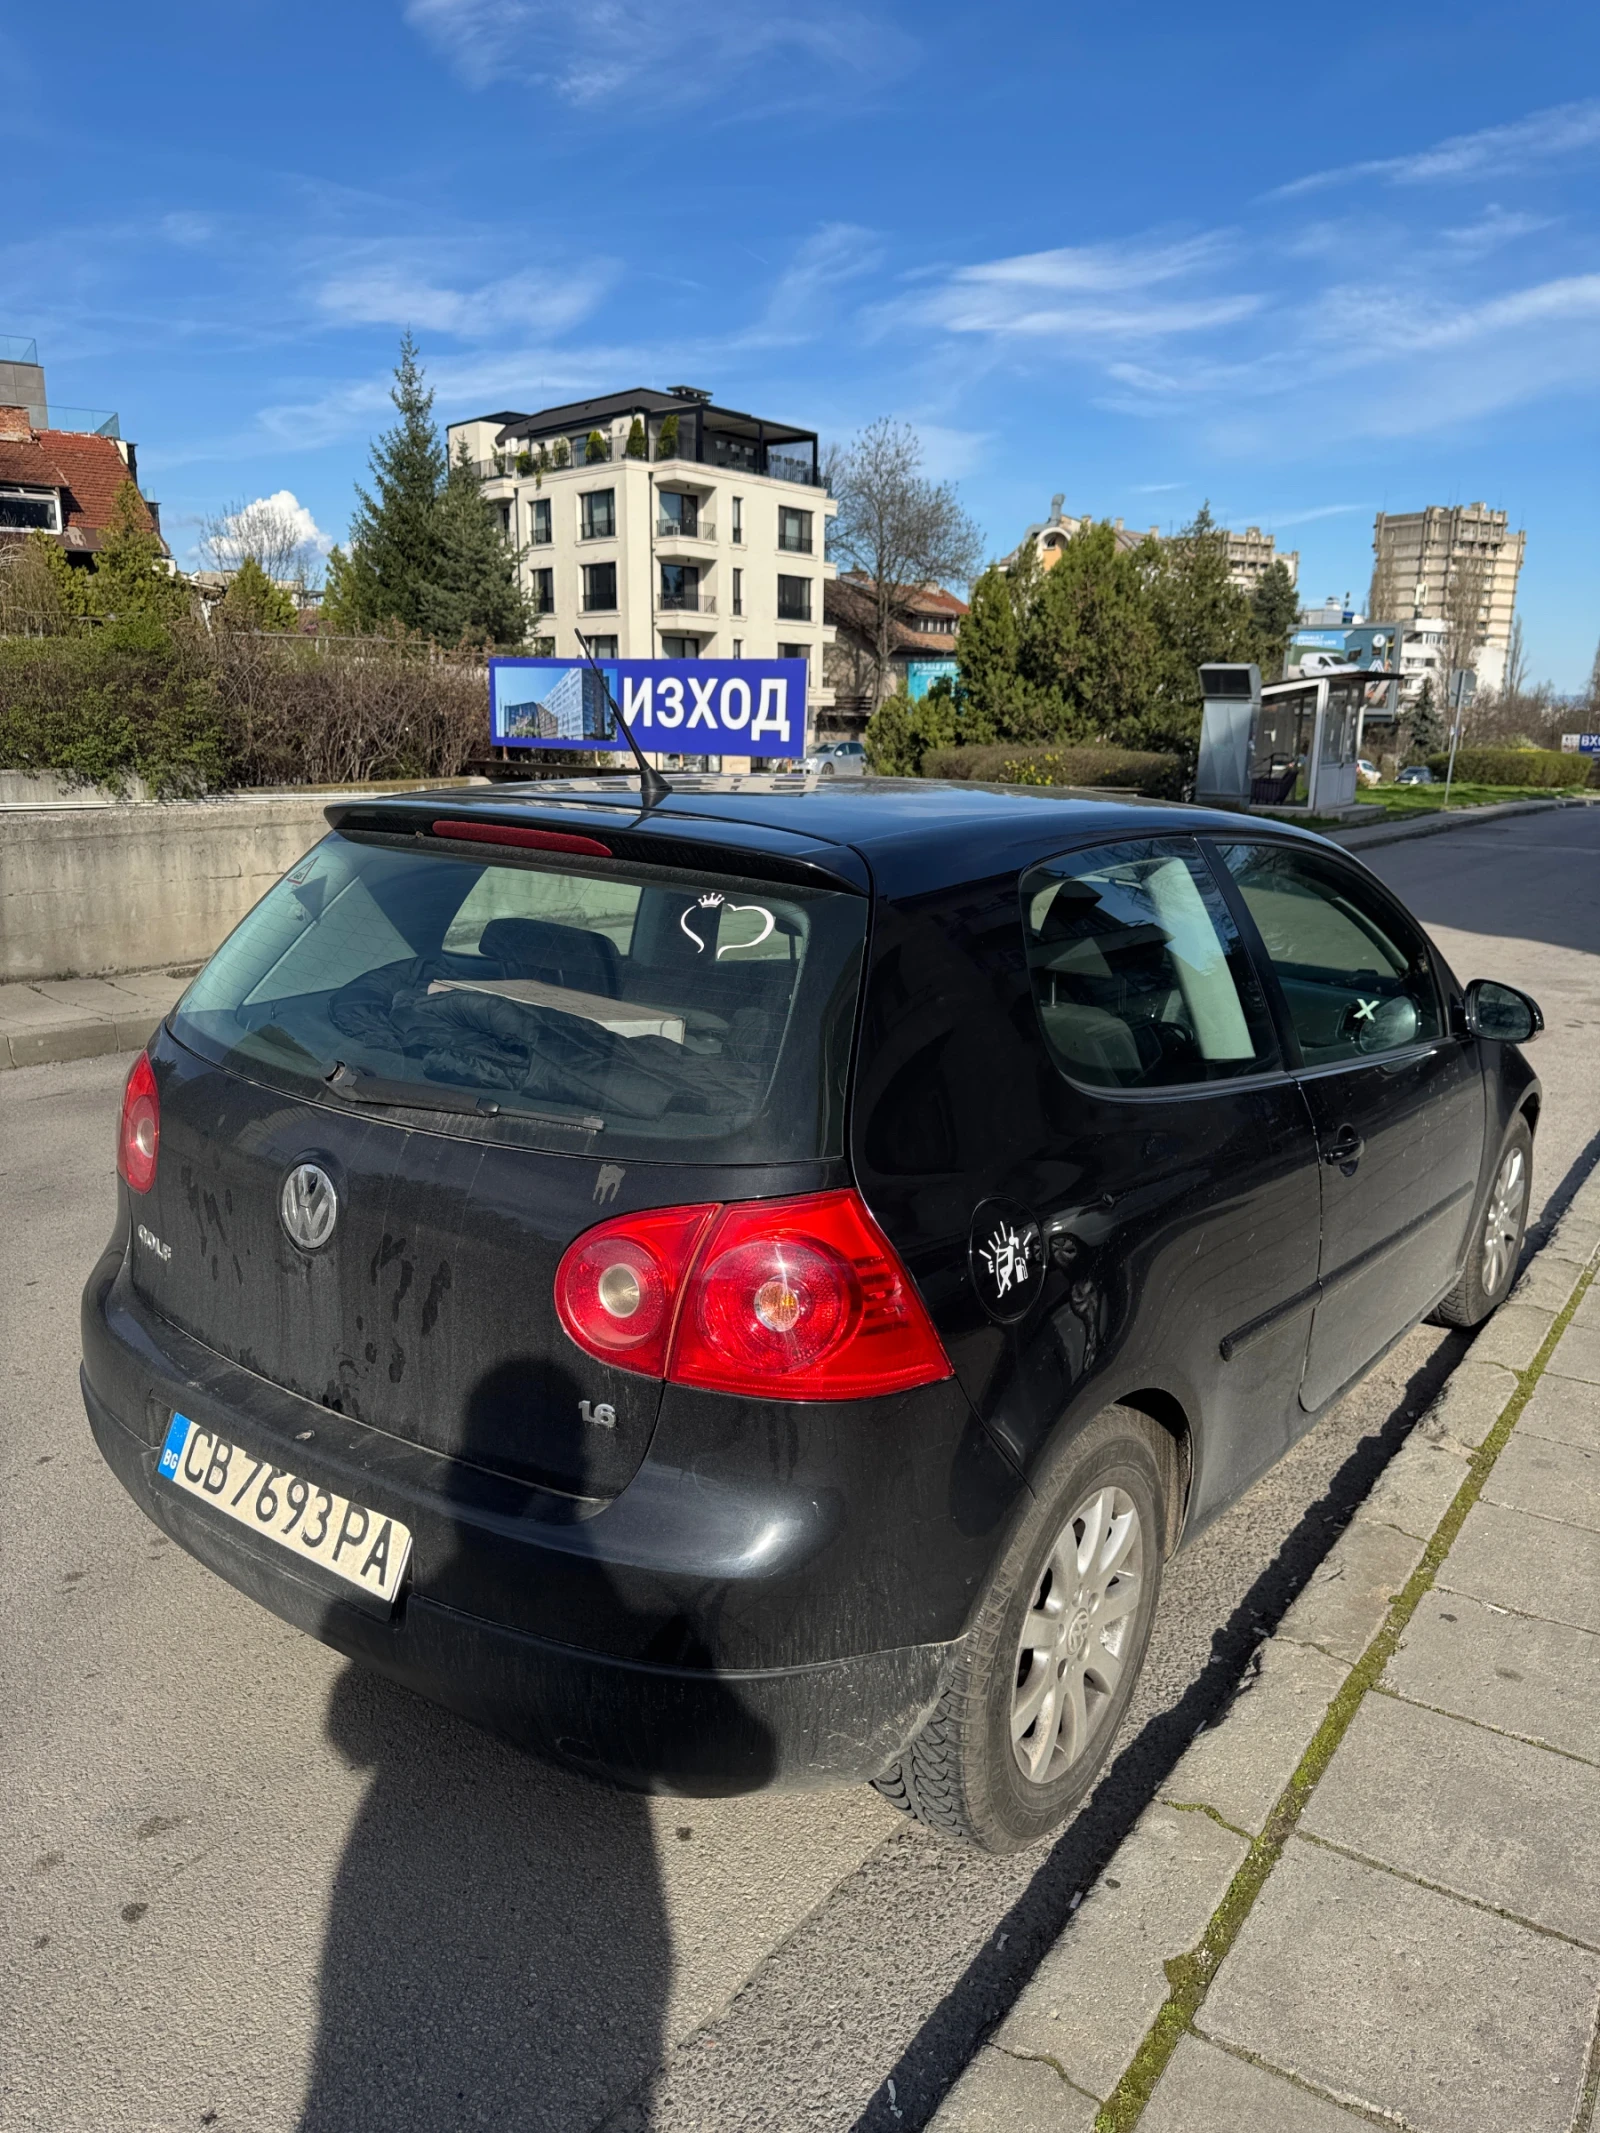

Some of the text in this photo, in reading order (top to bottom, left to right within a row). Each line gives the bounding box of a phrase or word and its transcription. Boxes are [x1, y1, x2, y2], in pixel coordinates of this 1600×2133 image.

[623, 677, 790, 742] ИЗХОД
[1581, 735, 1600, 746] ВХ
[137, 1224, 172, 1262] GOLF
[162, 1448, 179, 1470] BG
